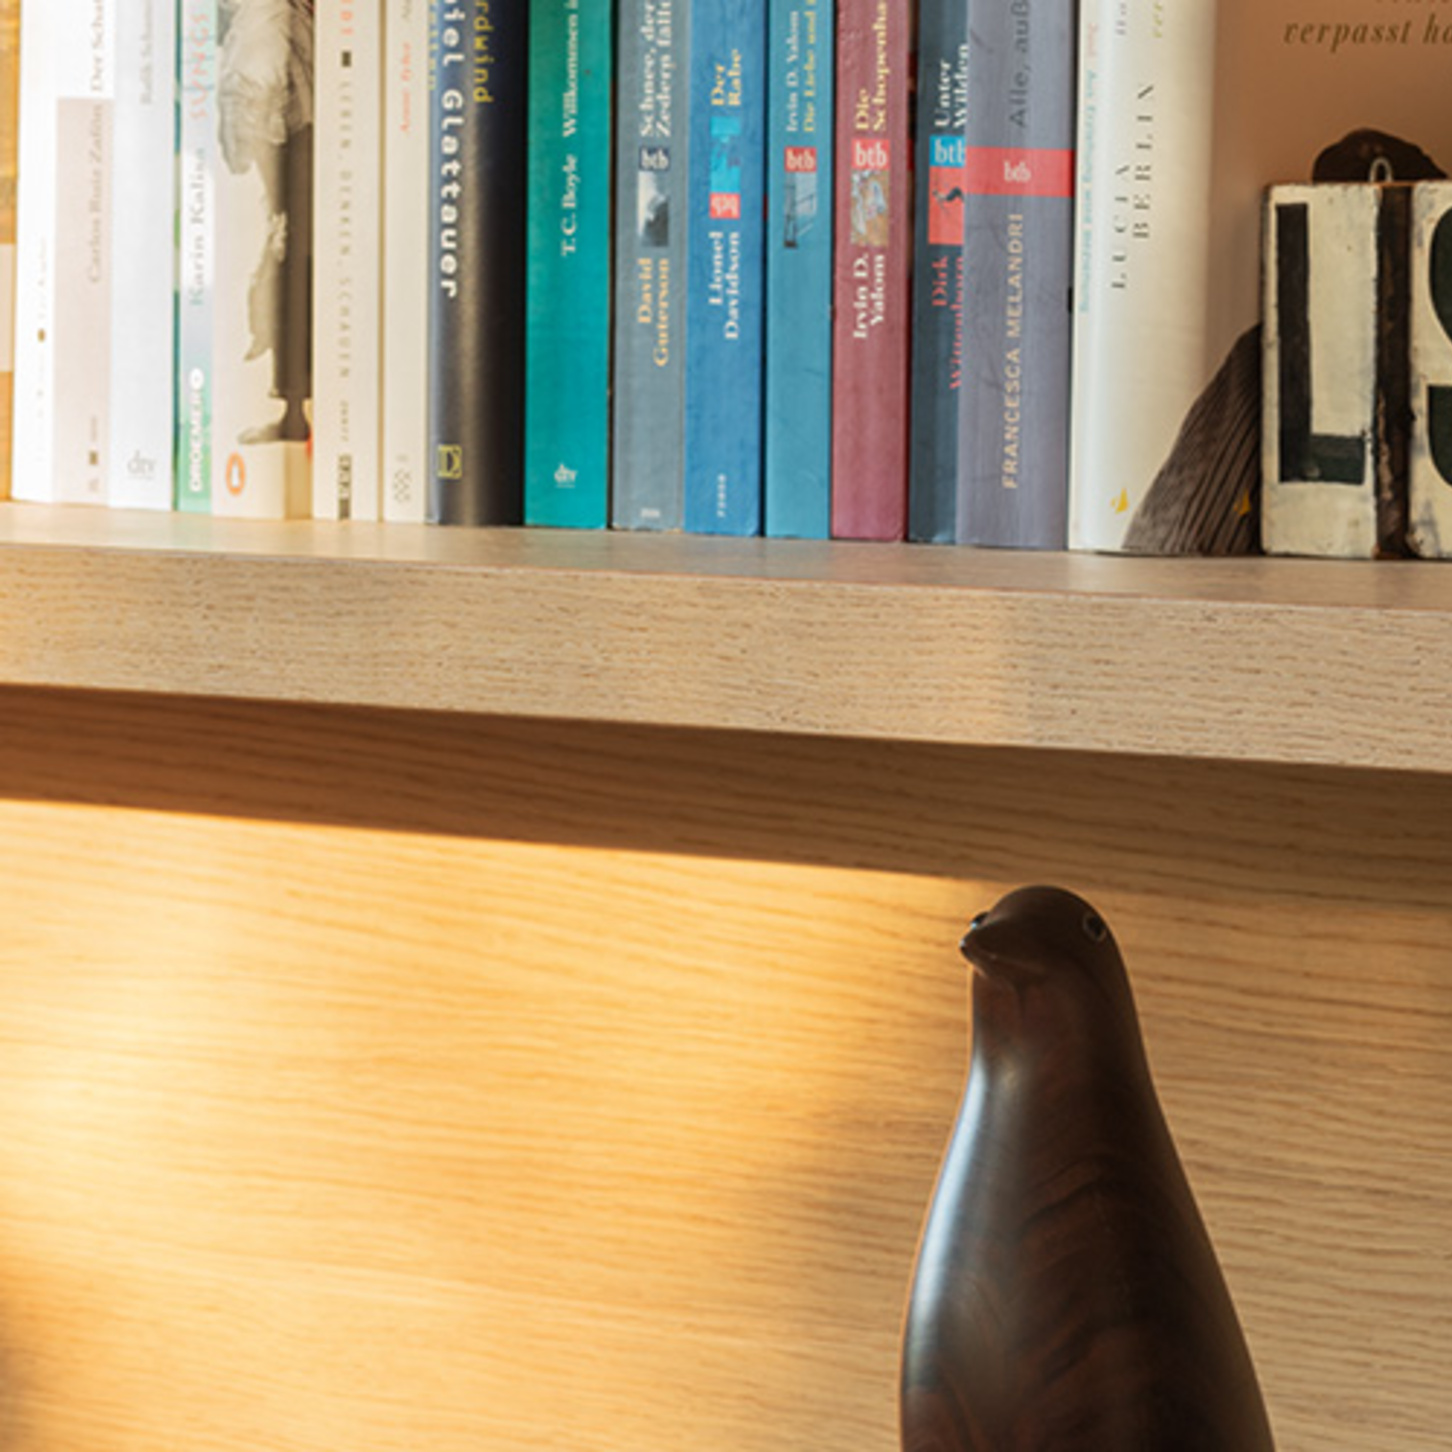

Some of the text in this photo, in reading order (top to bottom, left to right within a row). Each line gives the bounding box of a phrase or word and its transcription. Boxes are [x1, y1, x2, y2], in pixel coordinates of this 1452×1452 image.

[1283, 19, 1412, 54] verpasst
[561, 14, 579, 138] Willkommen
[640, 47, 657, 138] Schnee,
[656, 53, 672, 138] Zedern
[710, 62, 725, 106] Der
[855, 88, 869, 131] Die
[933, 59, 951, 127] Unter
[952, 44, 969, 128] Wilden
[1008, 62, 1029, 129] Alle,
[562, 153, 581, 210] Boyle
[786, 148, 816, 170] btb
[852, 141, 887, 168] btb
[1003, 161, 1031, 183] btb
[1131, 83, 1154, 239] BERLIN
[440, 88, 466, 298] Glattauer
[1110, 164, 1130, 290] LUCIA
[188, 235, 205, 306] Karin
[637, 257, 653, 324] David
[708, 231, 723, 305] Lionel
[724, 231, 740, 340] Davidson
[853, 252, 868, 338] Irvin D.
[869, 254, 885, 327] Yalom
[932, 256, 948, 307] Dirk
[653, 257, 670, 367] Guterson
[1002, 212, 1023, 490] FRANCESCA MELANDRI
